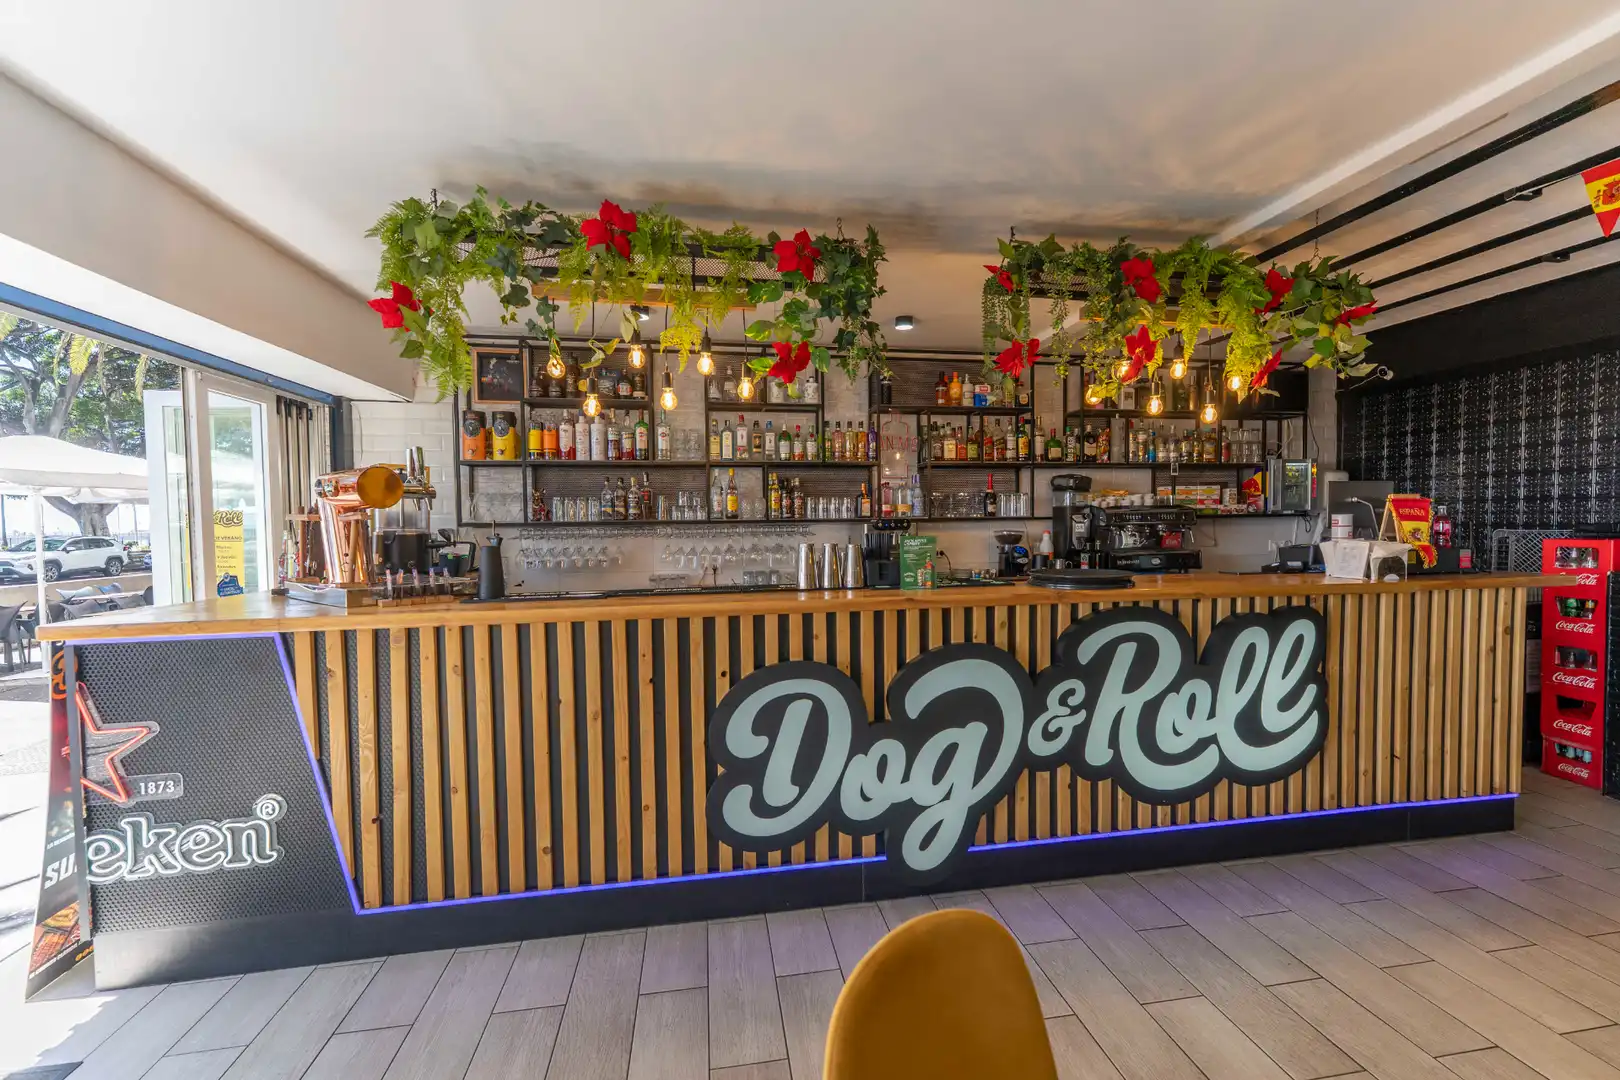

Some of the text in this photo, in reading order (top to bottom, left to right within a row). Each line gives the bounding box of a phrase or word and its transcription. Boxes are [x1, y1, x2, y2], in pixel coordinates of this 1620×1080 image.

[1400, 507, 1425, 516] ESPAÑA
[1555, 620, 1595, 634] Coca-Cola
[1552, 671, 1597, 689] Coca-Cola
[1553, 720, 1594, 737] Coca-Cola
[722, 618, 1318, 872] Dog & Roll
[1558, 763, 1590, 779] Coca-Cola
[139, 781, 175, 795] 1873
[44, 852, 77, 889] SU
